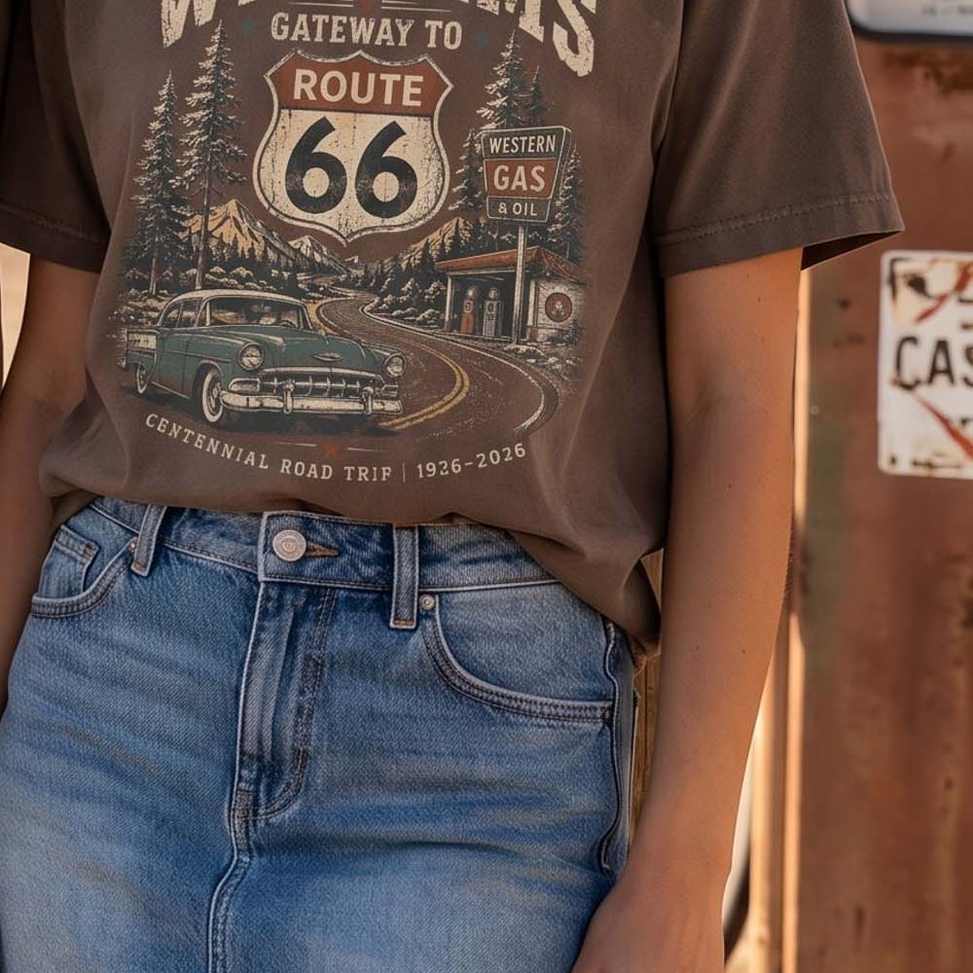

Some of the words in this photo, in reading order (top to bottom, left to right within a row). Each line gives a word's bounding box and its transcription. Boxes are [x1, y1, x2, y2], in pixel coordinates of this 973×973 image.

[271, 12, 413, 46] GATEWAY
[425, 19, 463, 50] TO
[293, 68, 424, 107] ROUTE
[489, 135, 556, 154] WESTERN
[285, 116, 418, 219] 66
[493, 164, 546, 192] GAS
[498, 201, 507, 214] &
[512, 202, 538, 216] OIL
[145, 413, 269, 470] CENTENNIAL
[279, 458, 333, 480] ROAD
[343, 465, 392, 482] TRIP
[417, 442, 526, 479] 1926-2026
